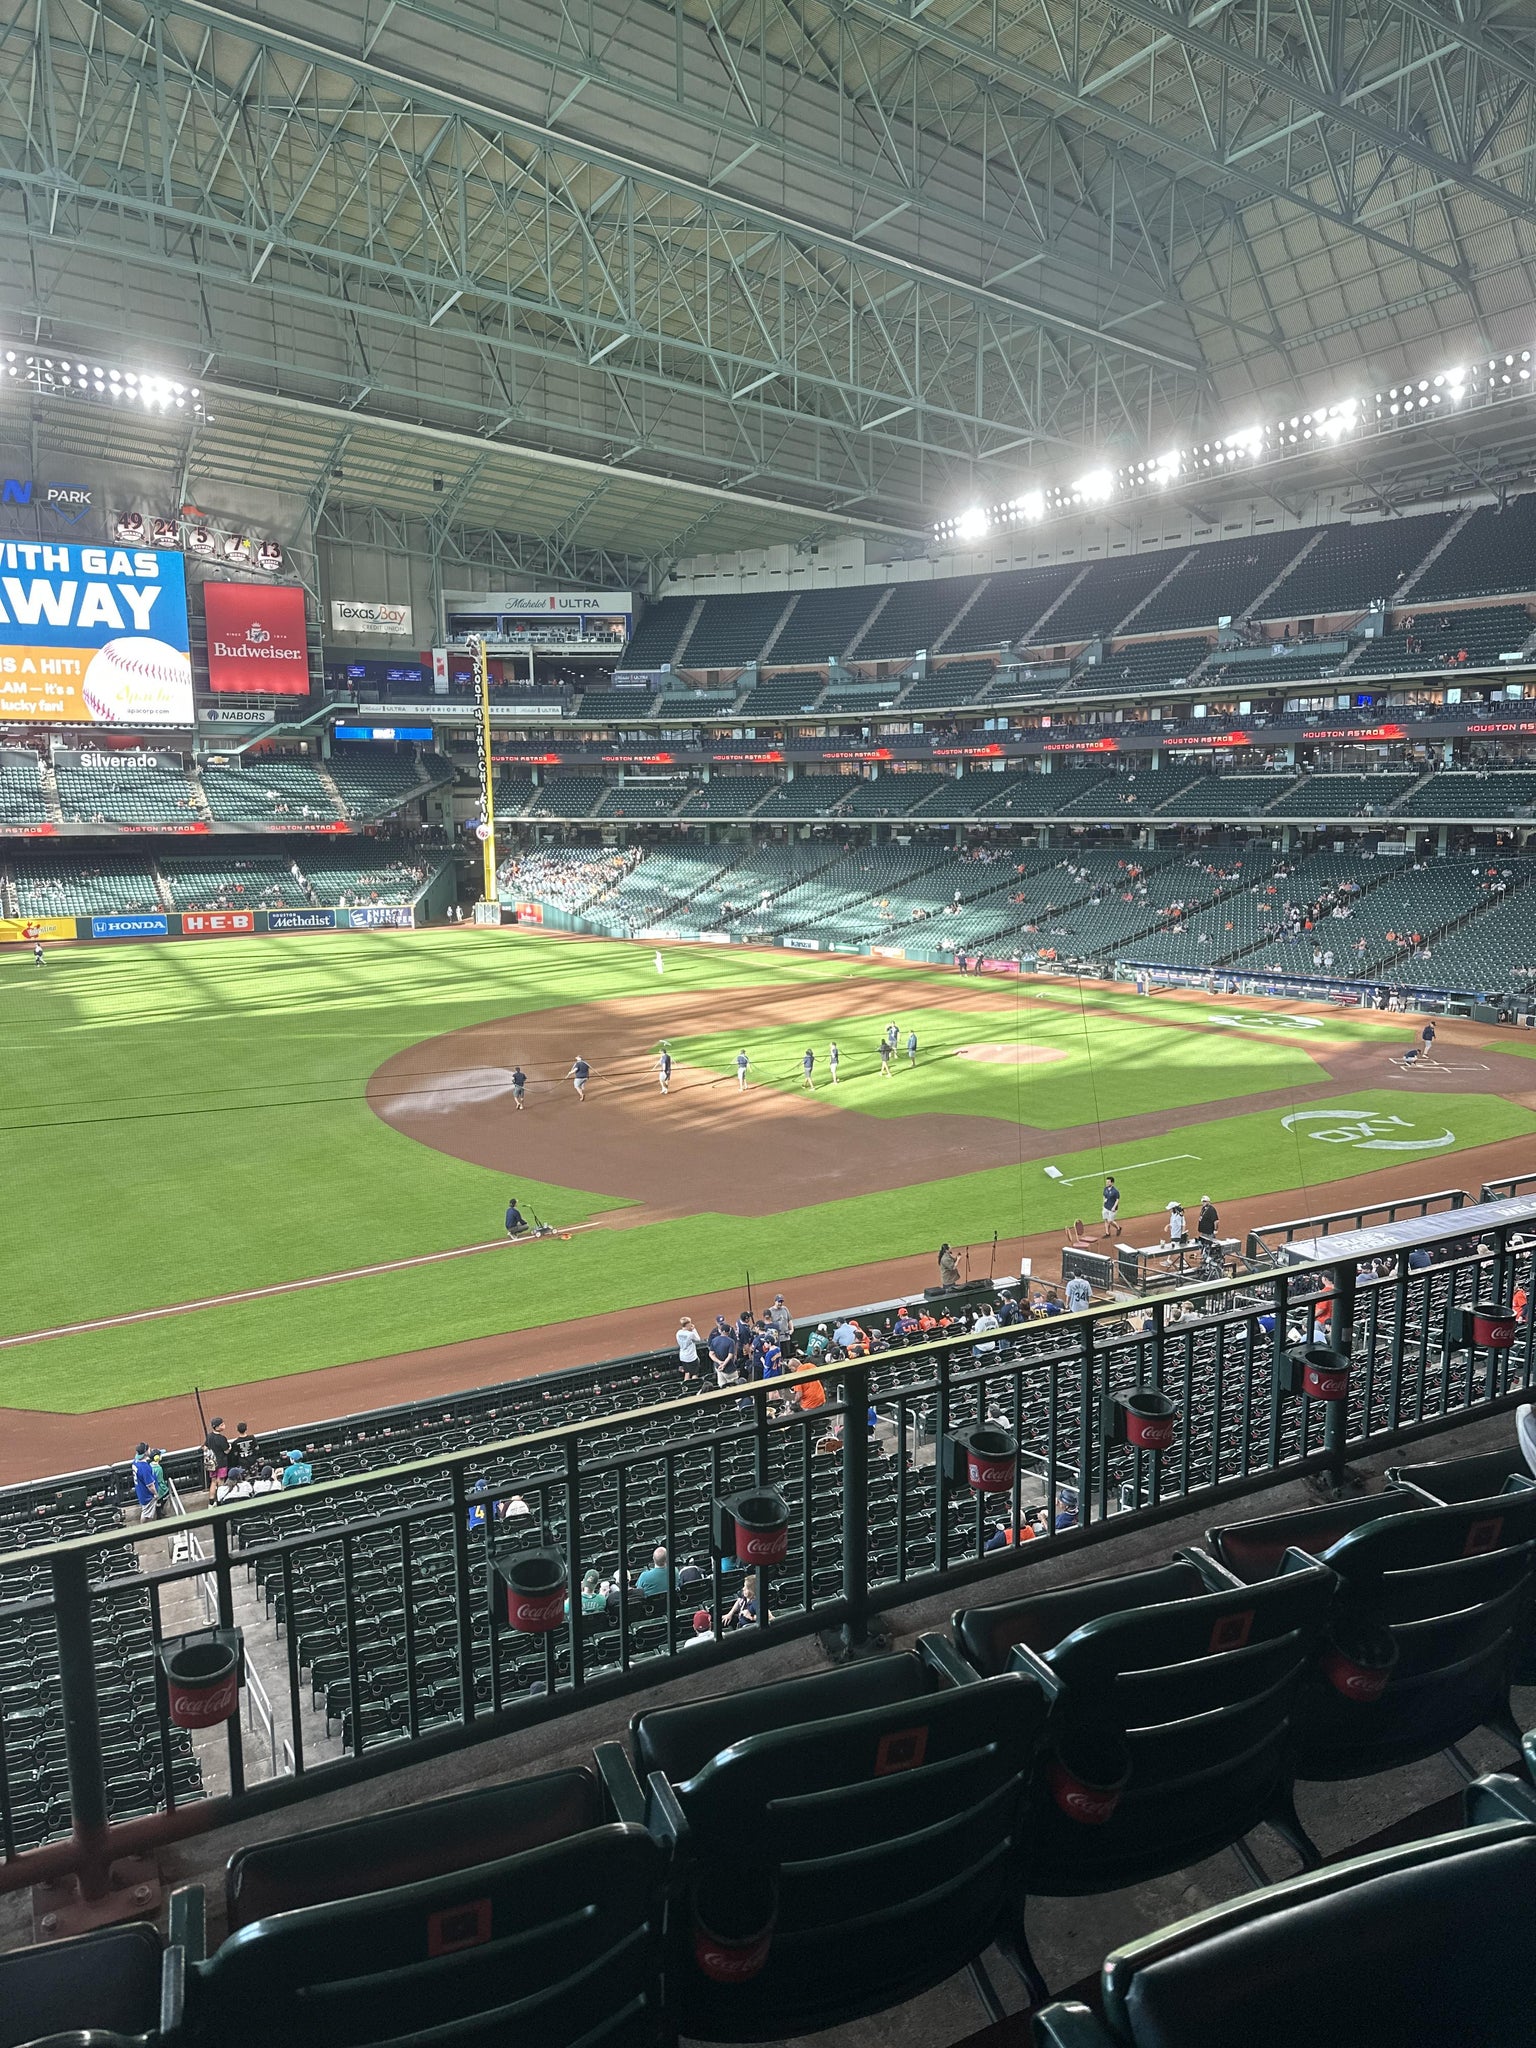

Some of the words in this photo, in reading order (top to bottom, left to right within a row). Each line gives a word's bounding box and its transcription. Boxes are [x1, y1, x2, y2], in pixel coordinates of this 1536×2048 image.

[47, 489, 92, 504] PARK
[119, 512, 143, 530] 49
[154, 519, 179, 537] 24
[195, 525, 208, 544] 5
[232, 535, 243, 551] 7
[260, 541, 281, 558] 13
[81, 548, 160, 578] GAS
[505, 597, 547, 610] Michelob
[559, 598, 600, 608] ULTRA
[337, 603, 375, 620] Texas
[379, 606, 406, 625] Bay
[21, 657, 37, 675] A
[40, 658, 81, 676] HIT!
[65, 686, 75, 696] a
[471, 662, 482, 705] ROOT
[1, 699, 37, 714] lucky
[473, 708, 482, 719] 4
[221, 711, 265, 721] NABORS
[1302, 730, 1345, 738] HOUSTON
[1347, 729, 1385, 737] ASTROS
[1466, 723, 1516, 732] HOUSTON
[475, 725, 487, 757] THA
[1162, 737, 1199, 745] HOUSTON
[80, 753, 157, 767] Silverado
[477, 761, 489, 824] CHIKIN
[108, 920, 166, 931] HONDA
[187, 915, 249, 930] H-E-B
[273, 914, 331, 927] Methodist
[1308, 1115, 1416, 1143] OXY
[1075, 1292, 1086, 1302] 34
[1034, 1308, 1049, 1318] 96
[902, 1324, 918, 1333] 44
[475, 1505, 485, 1519] 4
[175, 1683, 234, 1715] Coca-Cola
